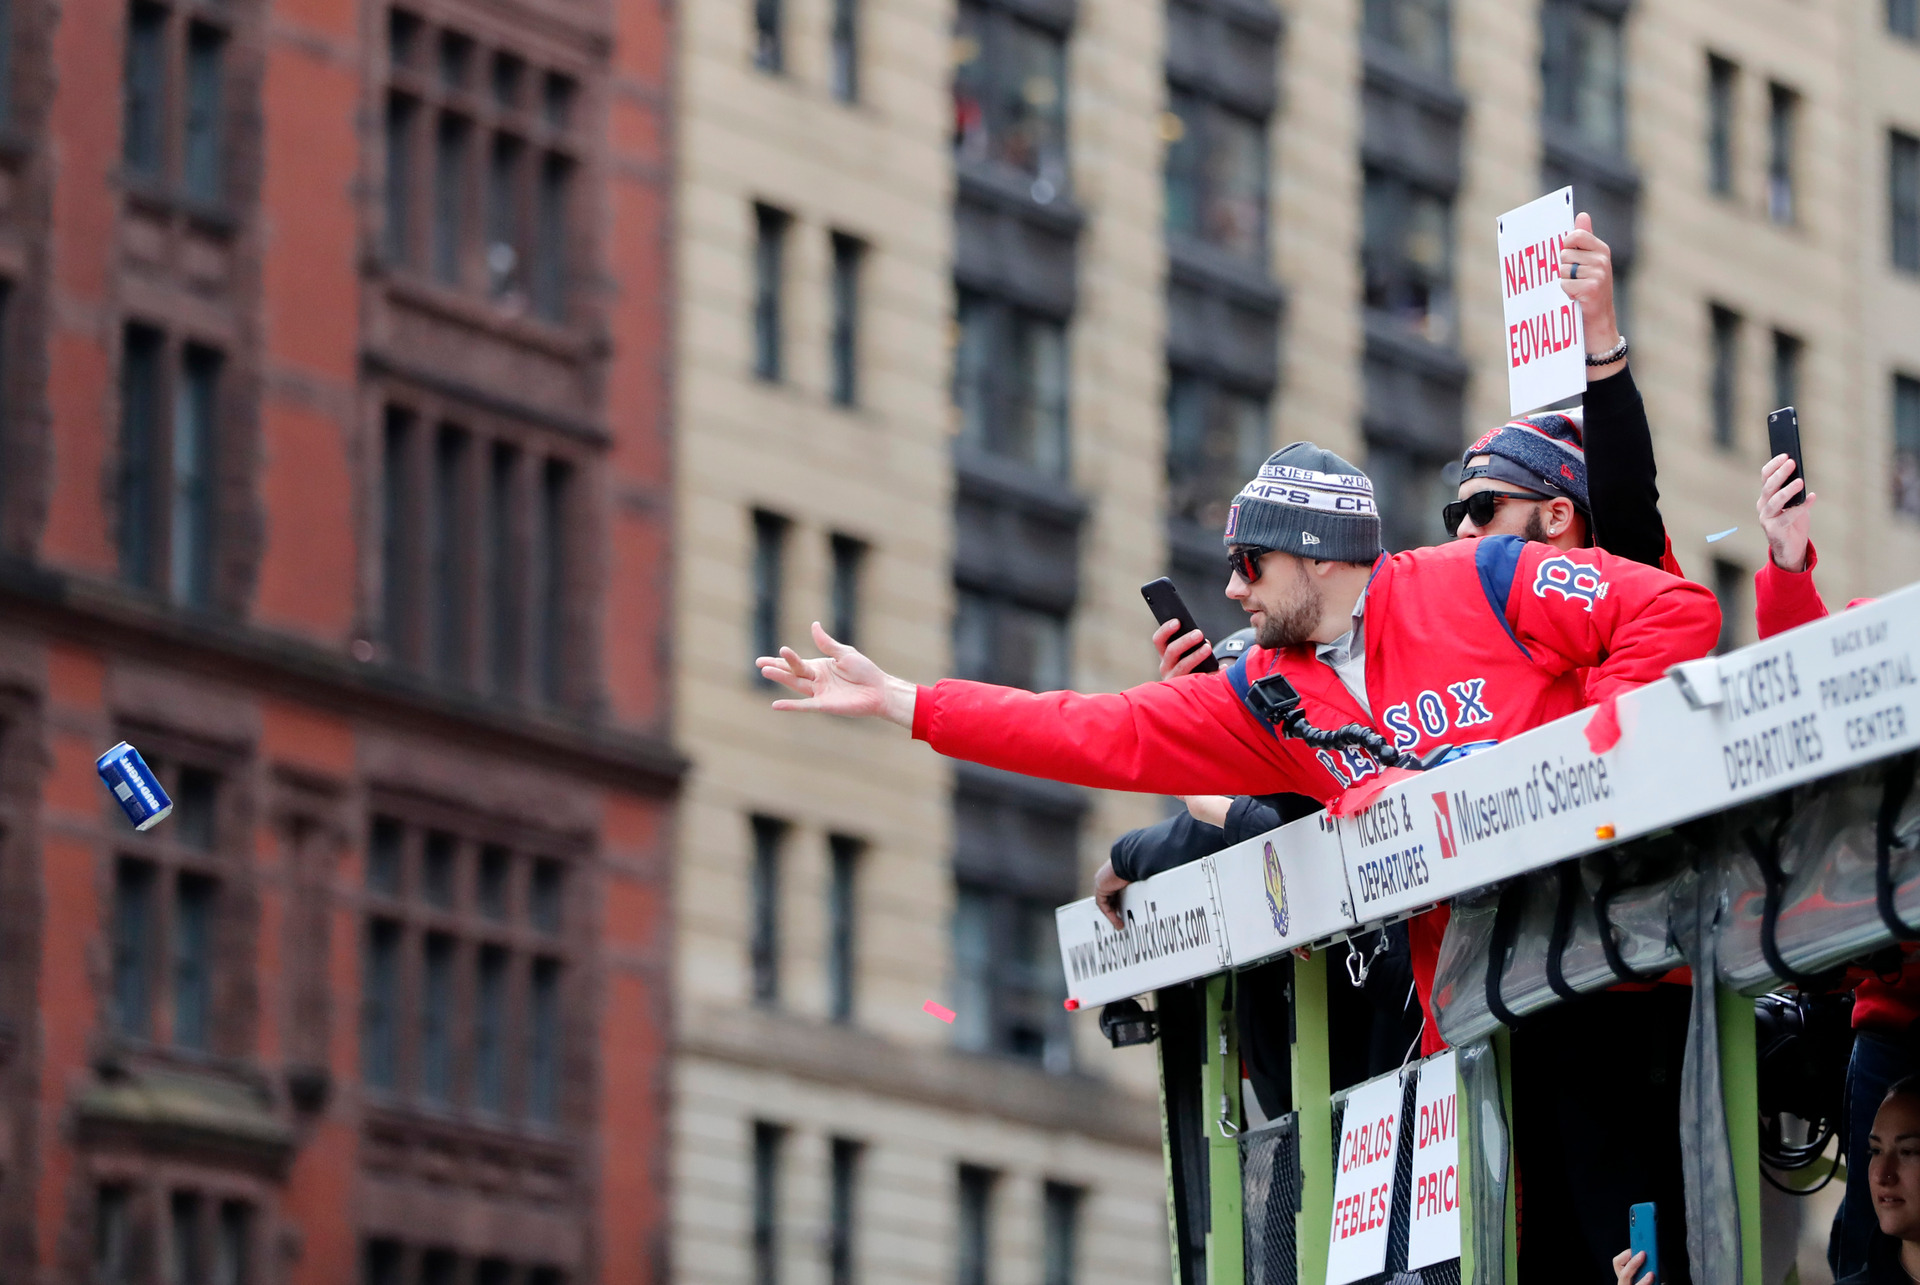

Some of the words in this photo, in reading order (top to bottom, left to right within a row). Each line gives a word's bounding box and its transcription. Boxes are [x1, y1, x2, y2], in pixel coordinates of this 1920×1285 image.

[1509, 301, 1577, 368] EOVALDI
[1243, 483, 1311, 505] MPS
[1338, 475, 1371, 489] WOR
[1831, 629, 1863, 657] BACK
[1866, 620, 1888, 646] BAY
[1721, 656, 1785, 721] TICKETS
[1786, 650, 1800, 698] &
[1819, 654, 1917, 711] PRUDENTIAL
[1316, 744, 1387, 789] RE
[1383, 678, 1493, 752] SOX
[1723, 713, 1824, 790] DEPARTURES
[1846, 705, 1908, 750] CENTER
[119, 755, 145, 788] LIGHT
[140, 786, 160, 810] BUD
[1354, 797, 1399, 848] TICKETS
[1400, 792, 1414, 833] &
[1454, 786, 1526, 846] Museum
[1526, 764, 1544, 822] of
[1541, 757, 1610, 816] Science
[1358, 844, 1429, 903] DEPARTURES
[1068, 900, 1211, 983] www.BostonDuckTours.com
[1342, 1114, 1394, 1174] CARLOS
[1419, 1093, 1456, 1149] DAVI
[1333, 1182, 1388, 1242] FEBLES
